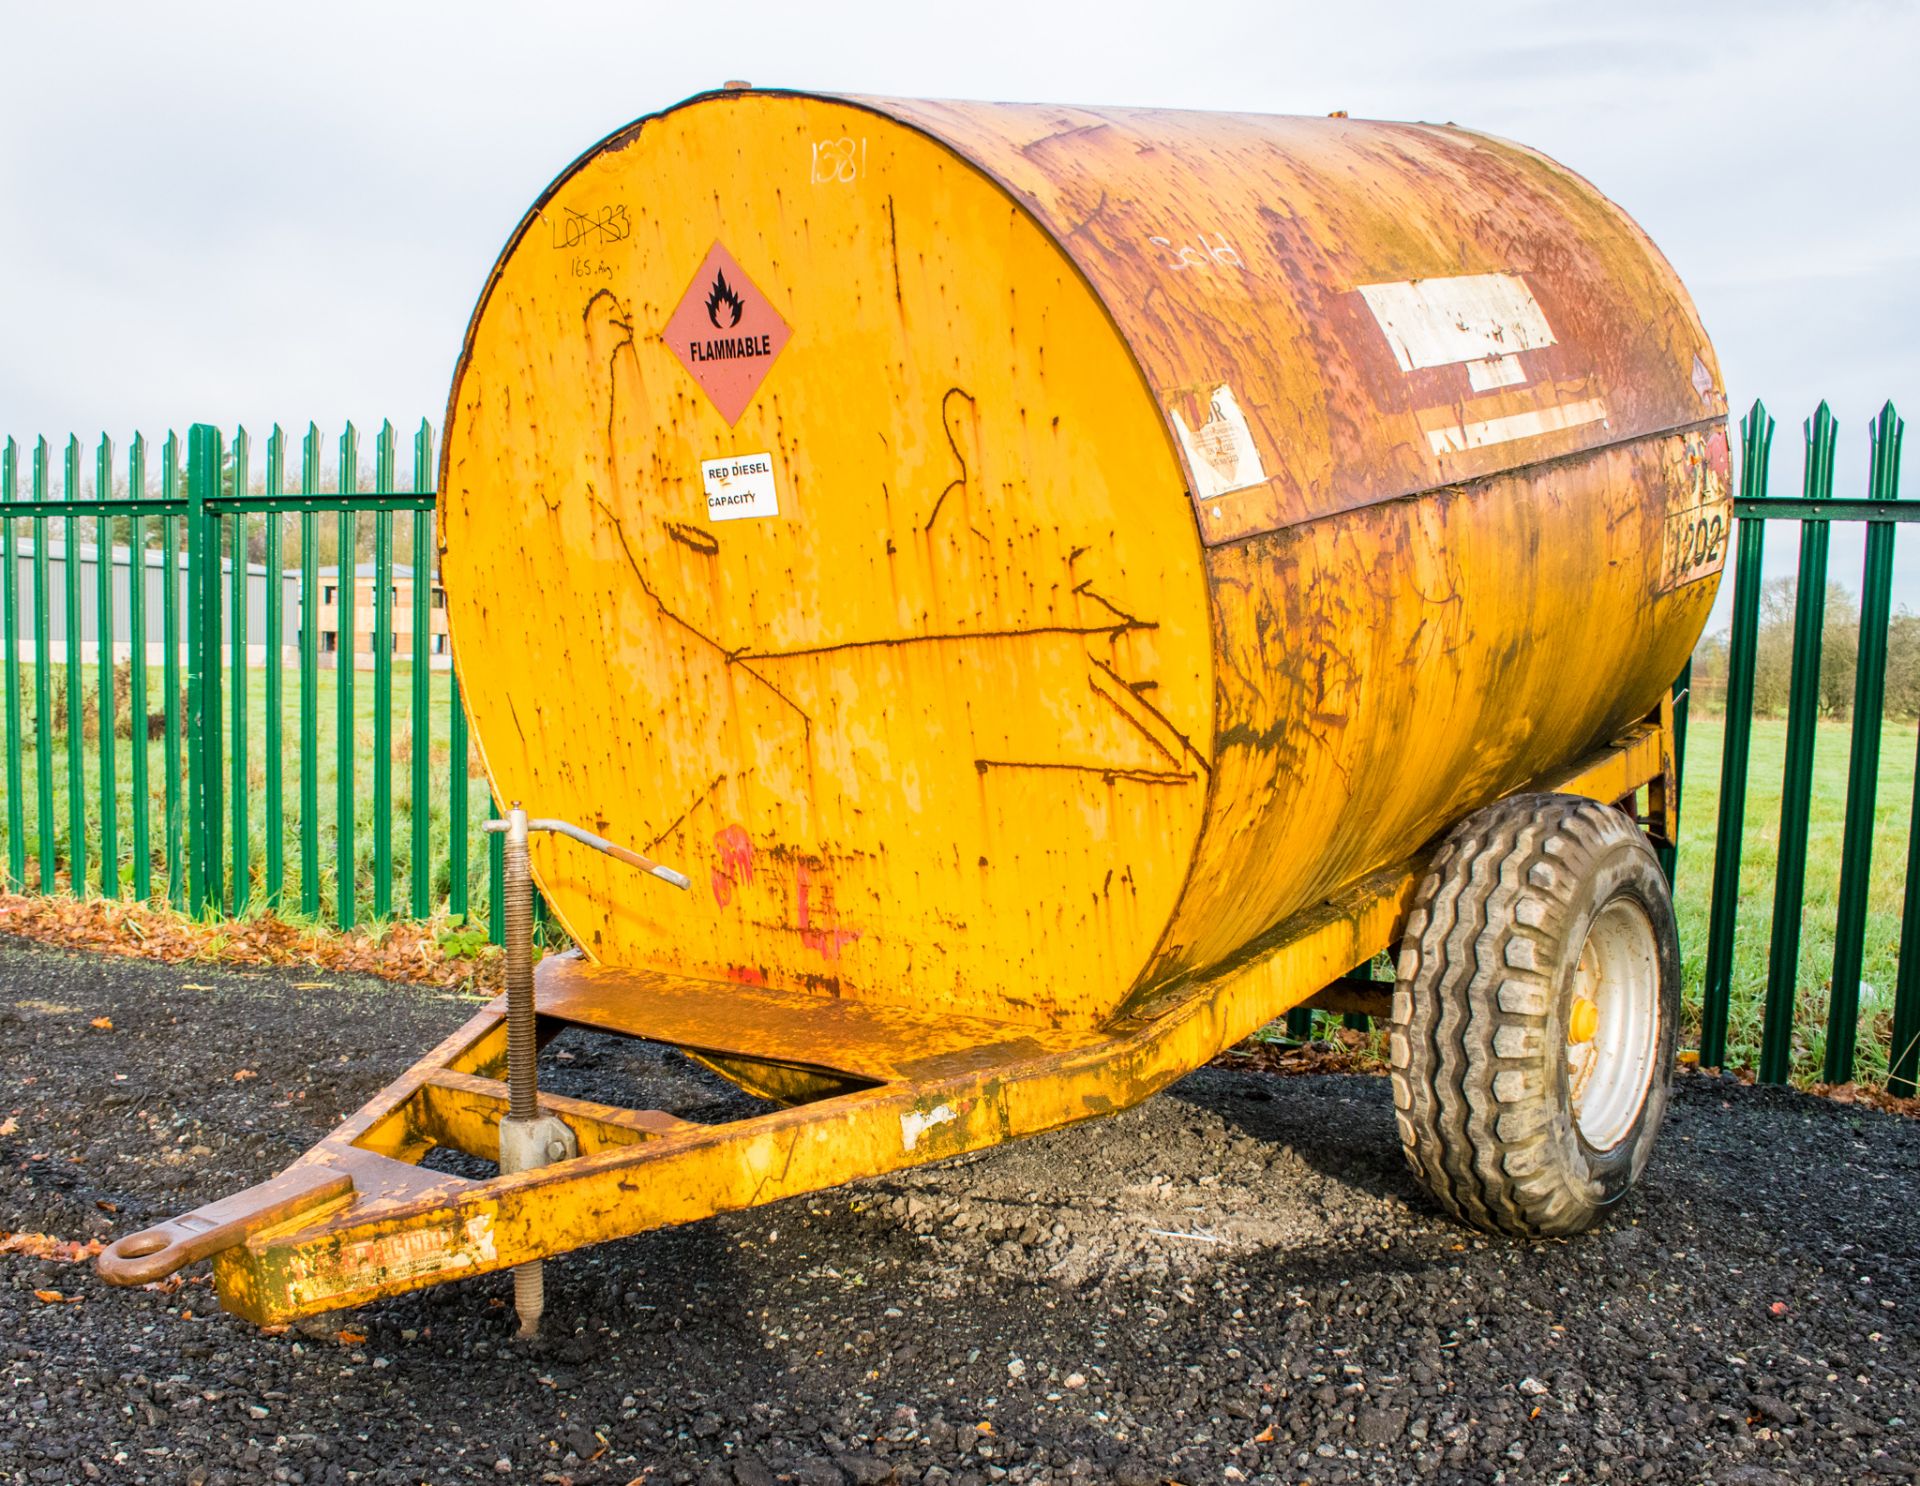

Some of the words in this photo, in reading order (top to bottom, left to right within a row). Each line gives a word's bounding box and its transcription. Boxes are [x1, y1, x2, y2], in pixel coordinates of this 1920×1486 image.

[810, 137, 867, 184] 1381
[552, 213, 589, 250] LOT
[690, 334, 771, 362] FLAMMABLE
[708, 467, 729, 479] RED
[731, 462, 769, 476] DIESEL
[708, 493, 756, 507] CAPACITY
